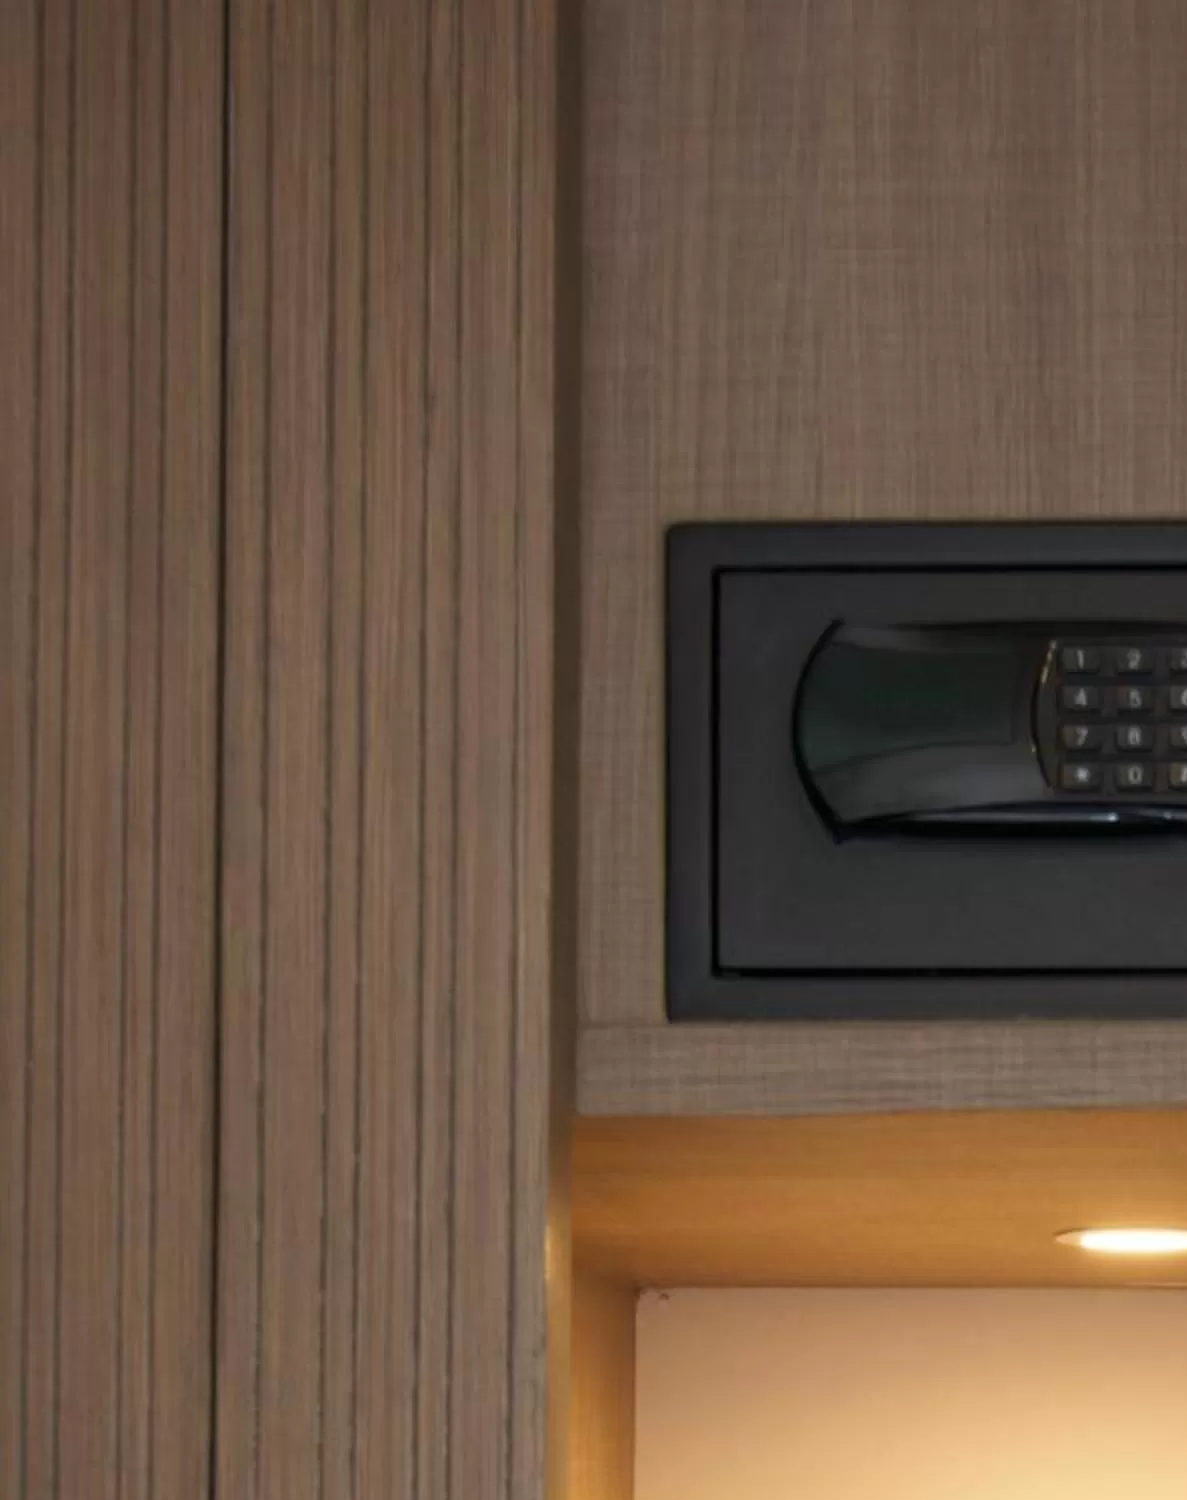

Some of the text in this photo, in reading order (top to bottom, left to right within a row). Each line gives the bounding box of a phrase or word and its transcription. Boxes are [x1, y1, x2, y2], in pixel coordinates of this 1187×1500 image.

[1128, 648, 1142, 669] 2
[1074, 688, 1088, 706] 4
[1129, 688, 1142, 707] 5
[1075, 728, 1089, 746] 7
[1128, 726, 1142, 745] 8
[1128, 765, 1143, 784] 0
